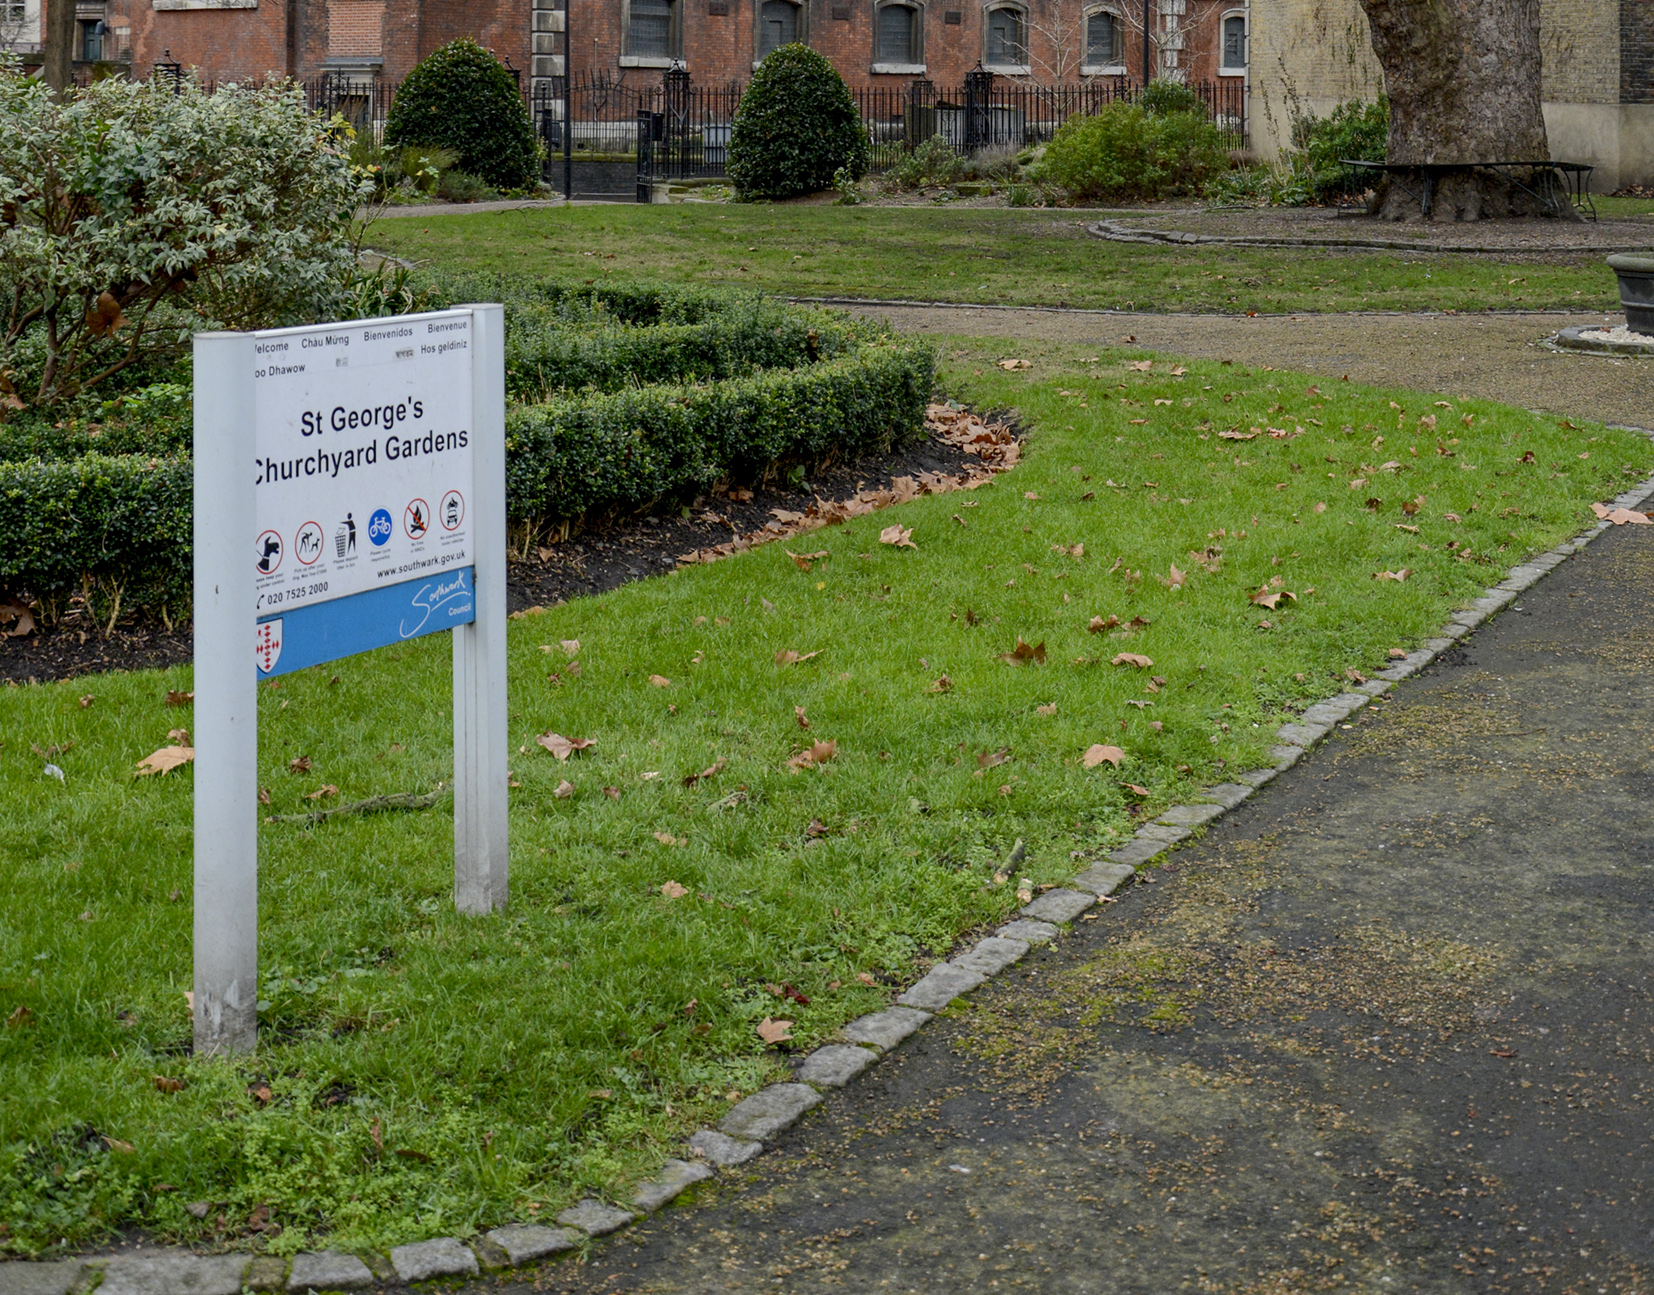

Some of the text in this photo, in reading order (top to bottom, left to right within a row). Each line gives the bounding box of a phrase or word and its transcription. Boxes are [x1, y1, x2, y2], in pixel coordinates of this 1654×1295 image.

[364, 327, 413, 341] Bienvenidos
[428, 321, 467, 333] Bienvenue
[255, 342, 289, 354] elcome
[438, 339, 467, 354] geldiniz
[269, 364, 306, 376] Dhawow
[301, 396, 424, 437] St George's
[385, 430, 468, 461] Gardens
[377, 549, 466, 578] www.southwark.gov.uk
[267, 581, 329, 605] 020 7525 2000
[448, 602, 472, 616] Council
